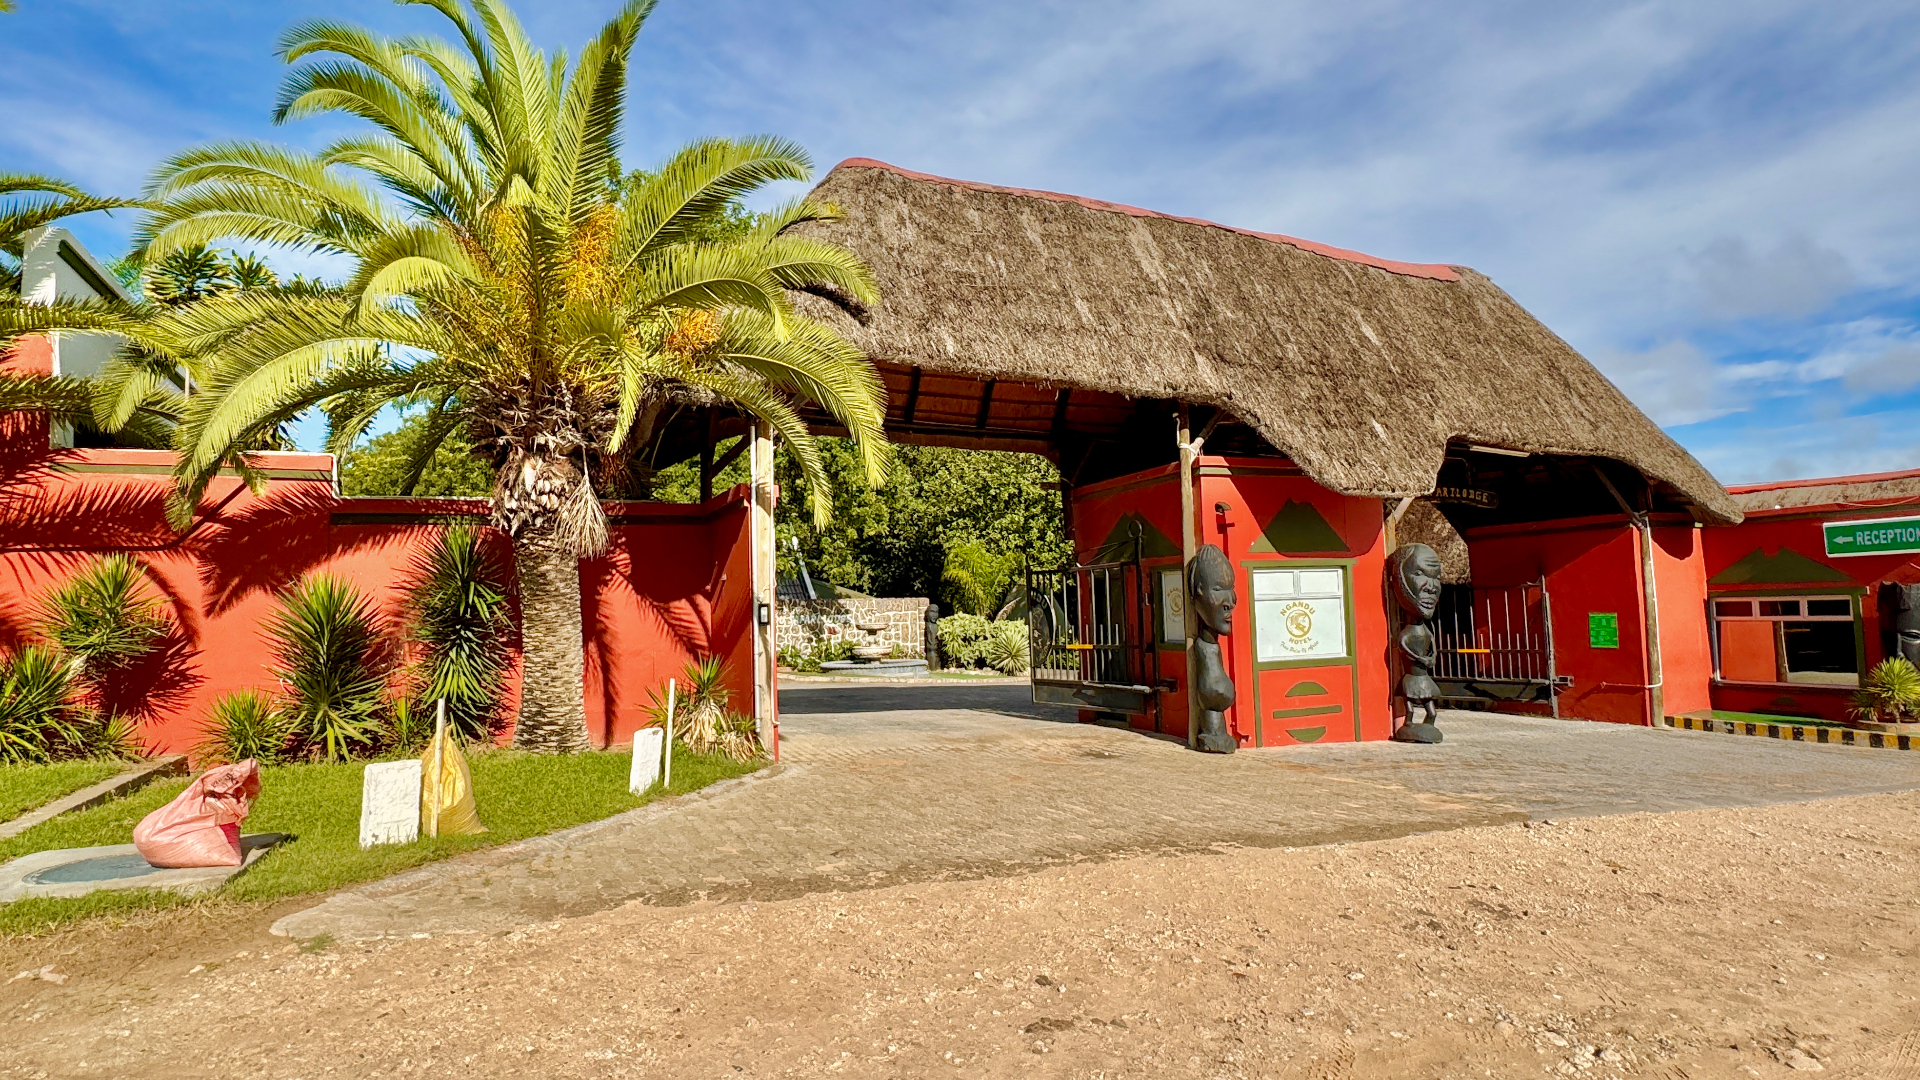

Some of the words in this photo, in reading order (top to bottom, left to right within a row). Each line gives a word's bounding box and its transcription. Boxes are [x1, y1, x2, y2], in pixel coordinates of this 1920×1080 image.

[1856, 528, 1920, 545] RECEPTION
[1280, 601, 1316, 616] NGANDU
[1289, 637, 1312, 645] HOTEL
